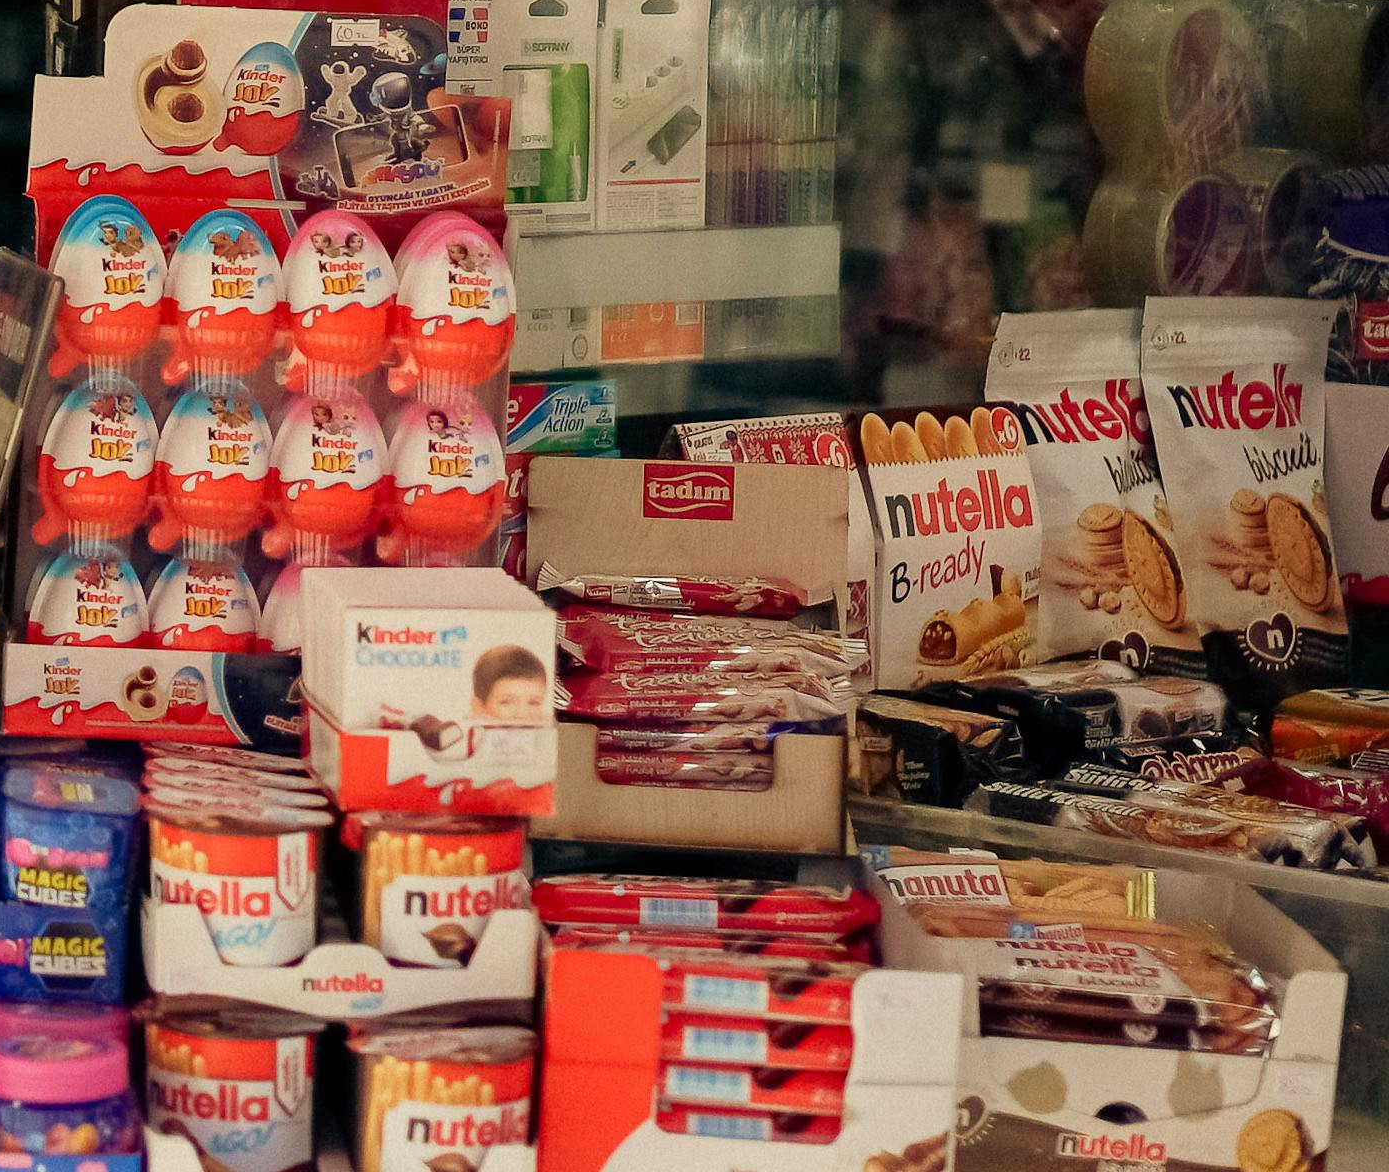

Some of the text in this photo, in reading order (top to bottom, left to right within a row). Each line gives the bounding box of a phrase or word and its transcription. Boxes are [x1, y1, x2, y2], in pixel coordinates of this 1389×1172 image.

[465, 21, 489, 31] BOND
[553, 396, 589, 417] Triple
[542, 414, 586, 434] Action
[884, 468, 1034, 540] nutella
[889, 534, 987, 606] B-ready
[17, 867, 89, 890] MAGIC
[879, 868, 1001, 900] hanuta
[16, 883, 89, 909] CUBES
[153, 874, 272, 918] nutella
[31, 935, 106, 957] MAGIC
[29, 954, 107, 978] CUBES
[1014, 956, 1162, 978] nutella
[302, 973, 384, 994] nutella
[149, 1086, 270, 1123] nutella
[1057, 1132, 1167, 1163] nutella
